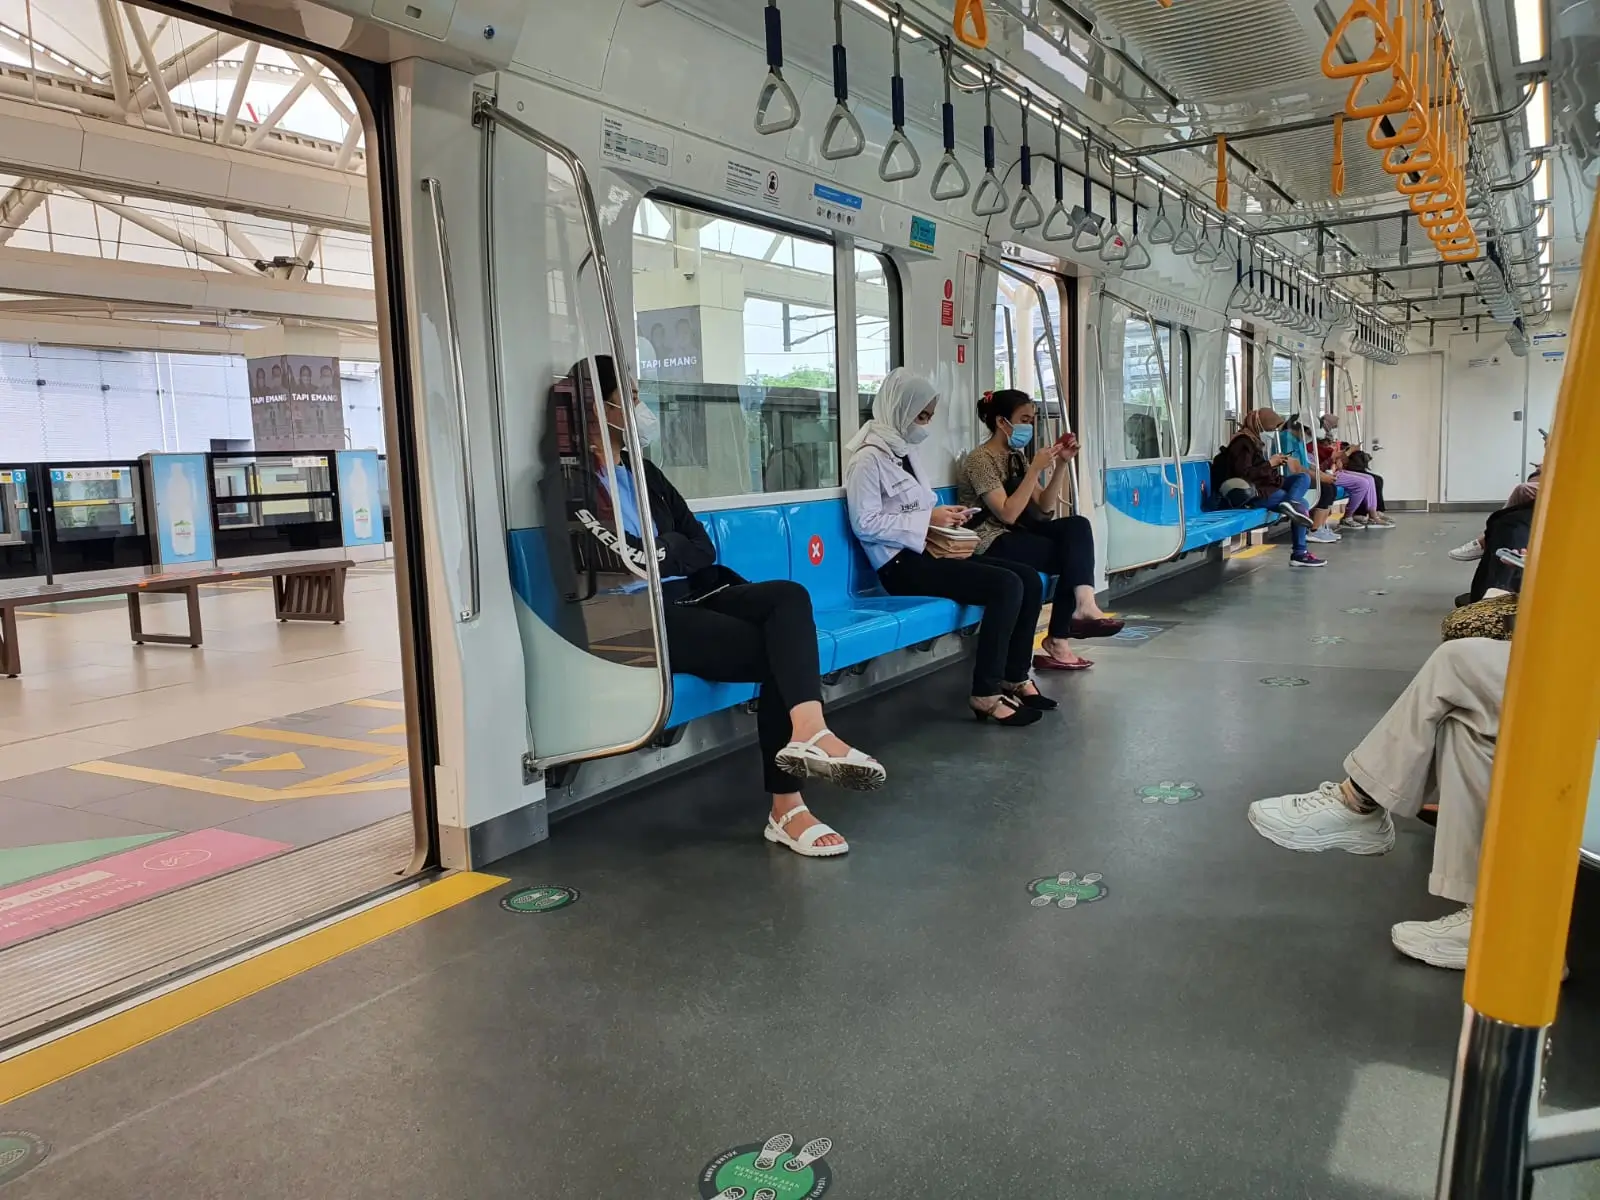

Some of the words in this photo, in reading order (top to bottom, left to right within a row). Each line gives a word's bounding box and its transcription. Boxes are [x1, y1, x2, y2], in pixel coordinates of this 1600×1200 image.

[641, 360, 661, 369] TAPI
[663, 356, 697, 368] EMANG
[252, 396, 264, 405] TAPI
[265, 394, 287, 403] EMANG
[292, 393, 309, 401] TAPI
[311, 393, 338, 402] EMANG
